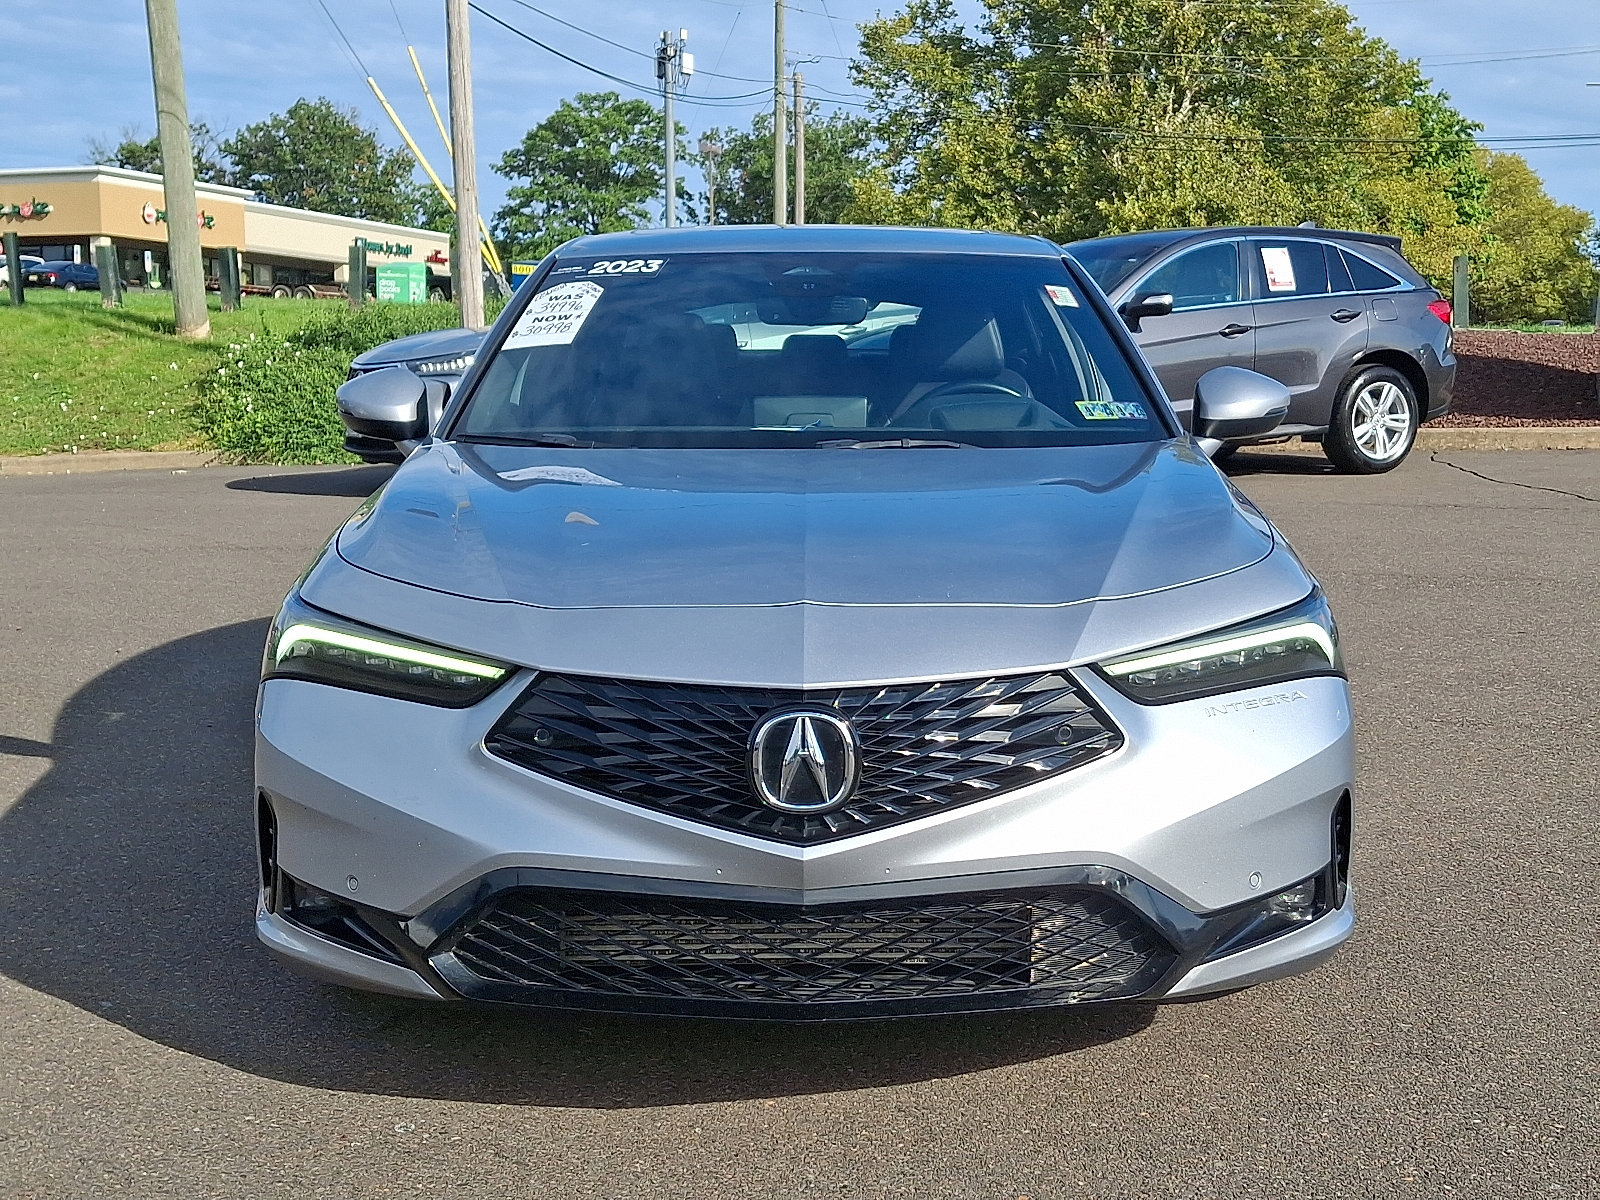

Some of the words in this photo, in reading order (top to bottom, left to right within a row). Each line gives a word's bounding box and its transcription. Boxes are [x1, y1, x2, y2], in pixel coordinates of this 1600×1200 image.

[587, 260, 663, 275] 2023
[548, 293, 584, 301] WAS
[532, 313, 574, 324] NOW
[1204, 690, 1308, 718] INTEGRA
